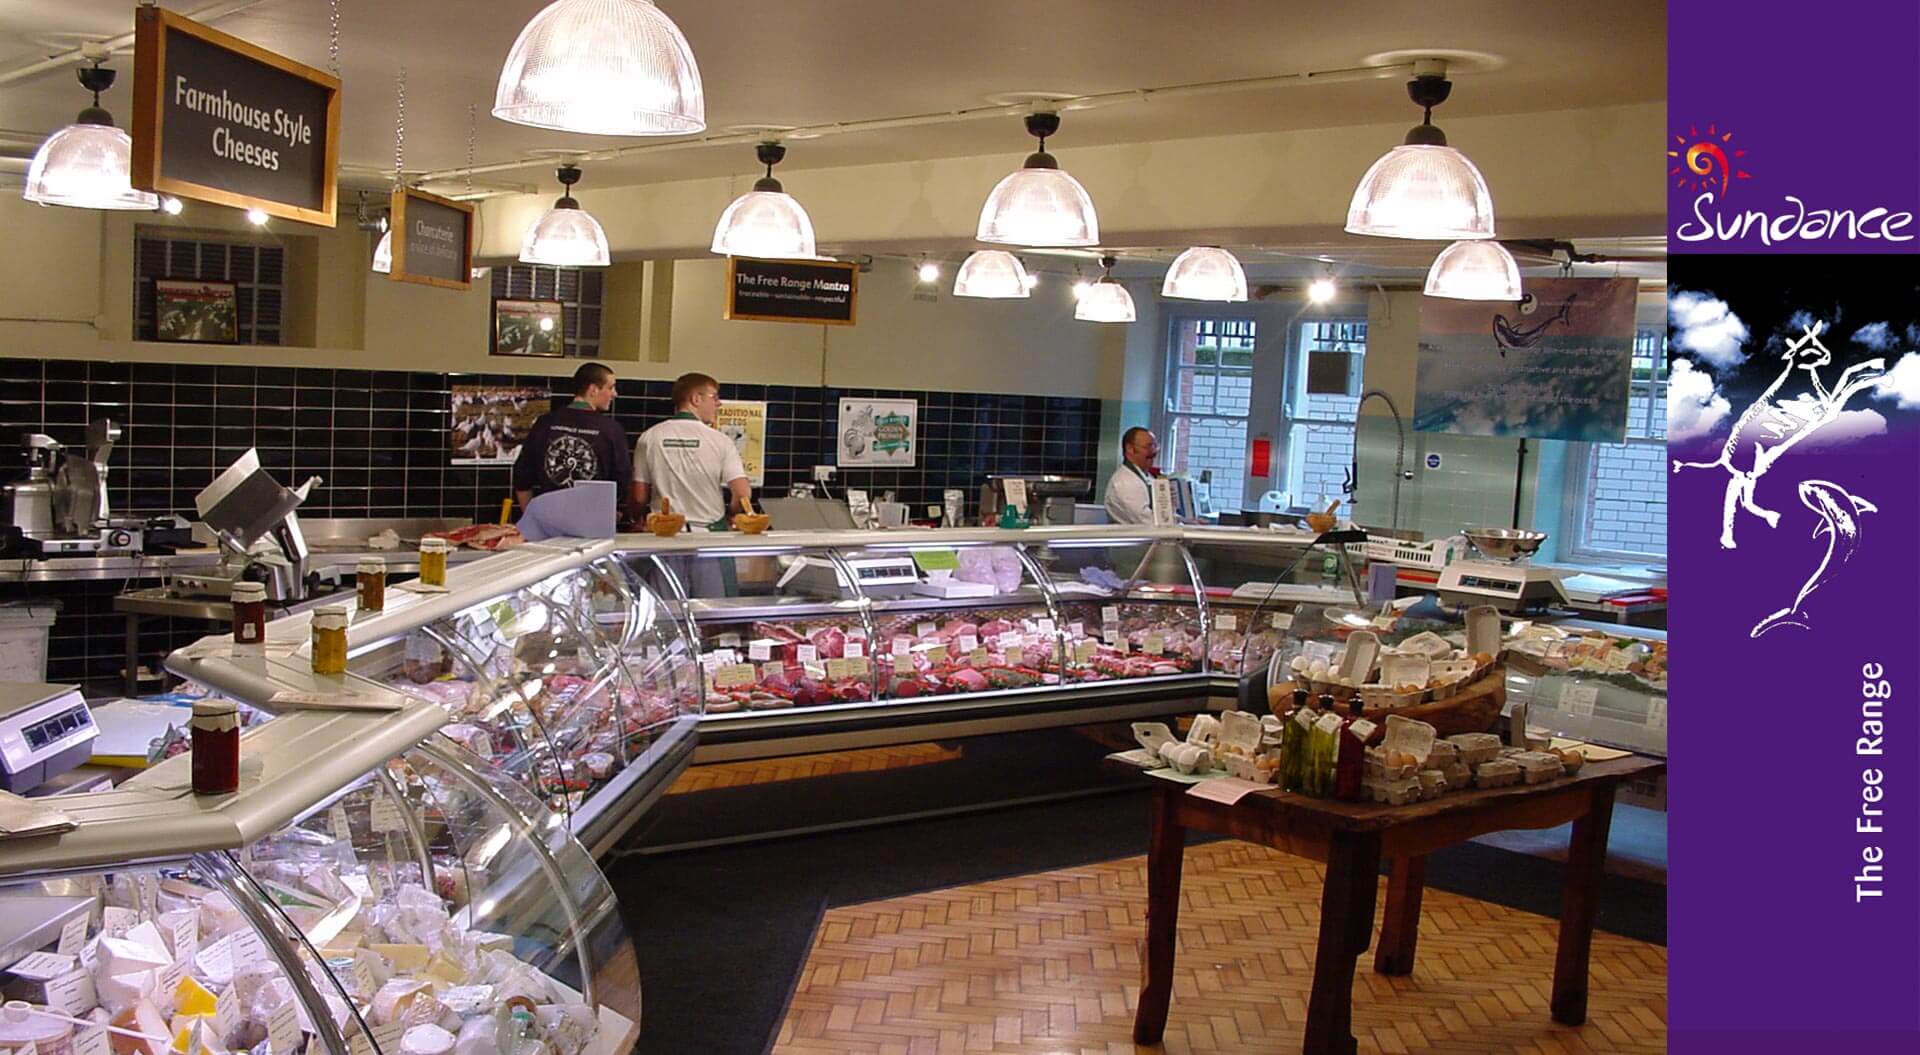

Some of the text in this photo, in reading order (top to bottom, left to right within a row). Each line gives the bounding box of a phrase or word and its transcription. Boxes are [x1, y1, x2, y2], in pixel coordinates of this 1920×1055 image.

[175, 75, 312, 148] Farmhouse Style
[212, 127, 279, 171] Cheeses
[736, 273, 850, 292] The Free Range Mantra
[718, 408, 762, 417] RADITIONAL
